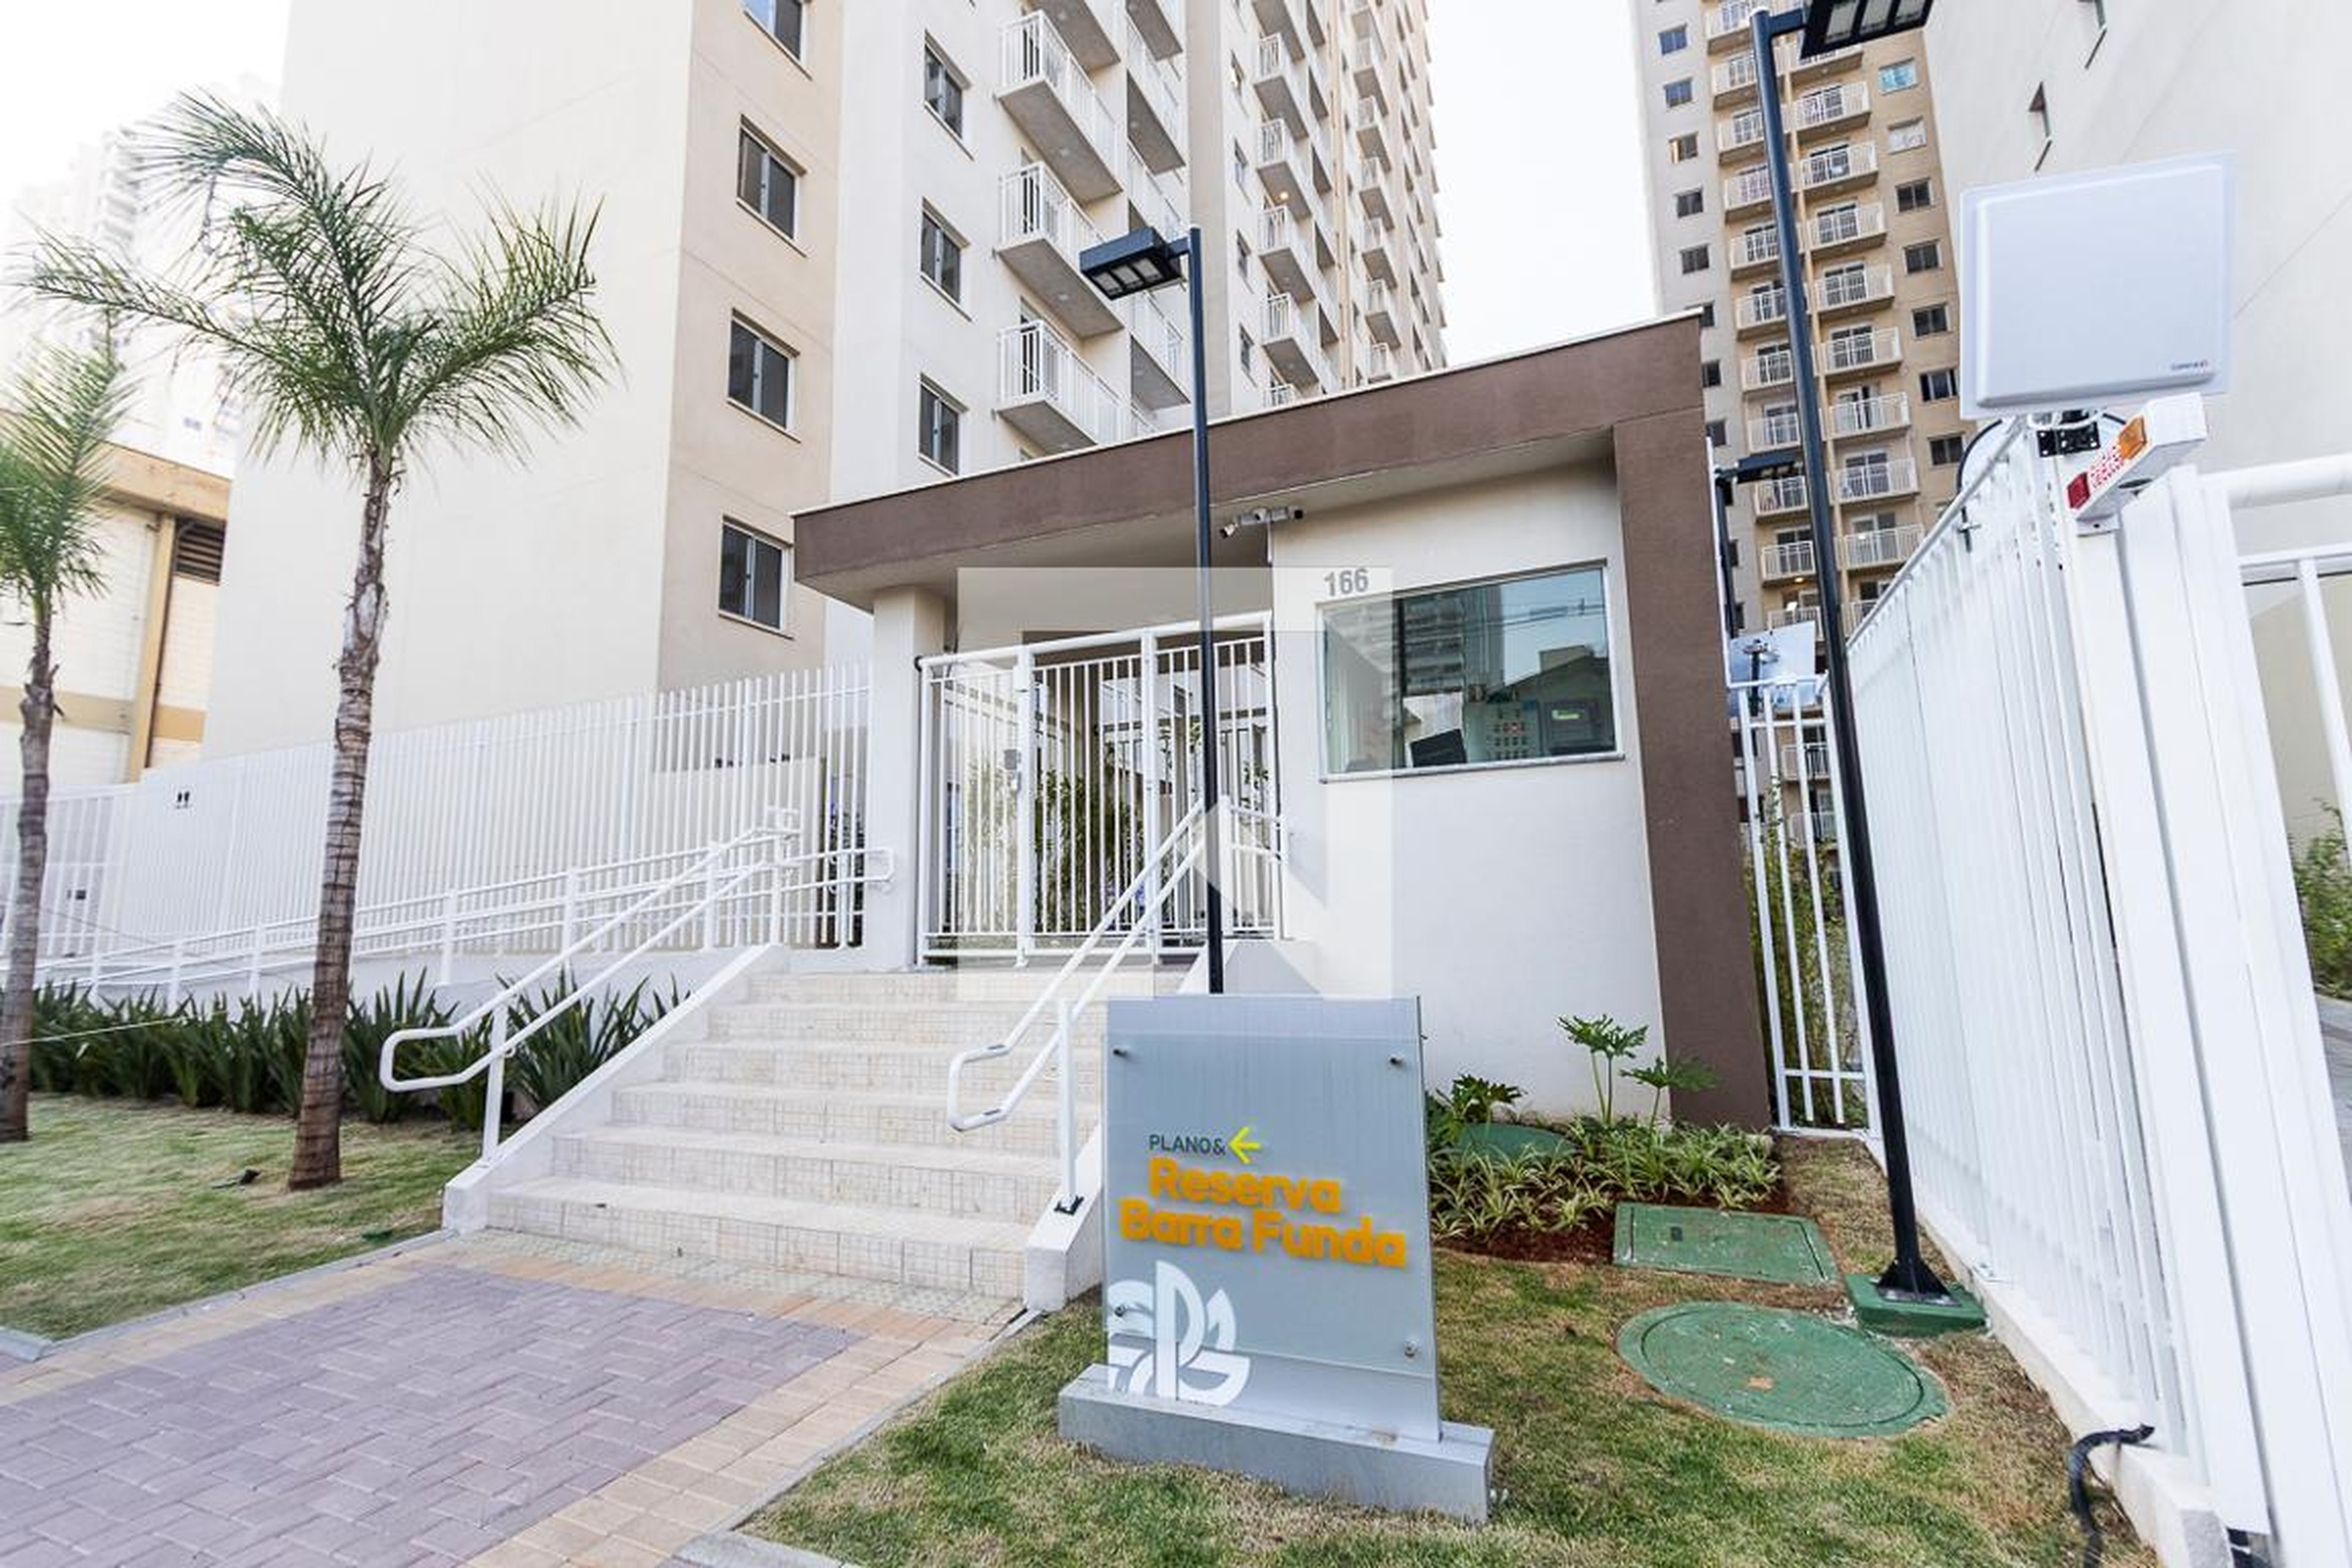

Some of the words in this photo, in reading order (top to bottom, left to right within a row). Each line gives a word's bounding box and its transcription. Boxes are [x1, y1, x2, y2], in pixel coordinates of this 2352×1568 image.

[1324, 568, 1369, 597] 166
[1149, 1156, 1341, 1214] Reserva
[1119, 1198, 1243, 1251] Barra
[1252, 1208, 1407, 1268] Funda
